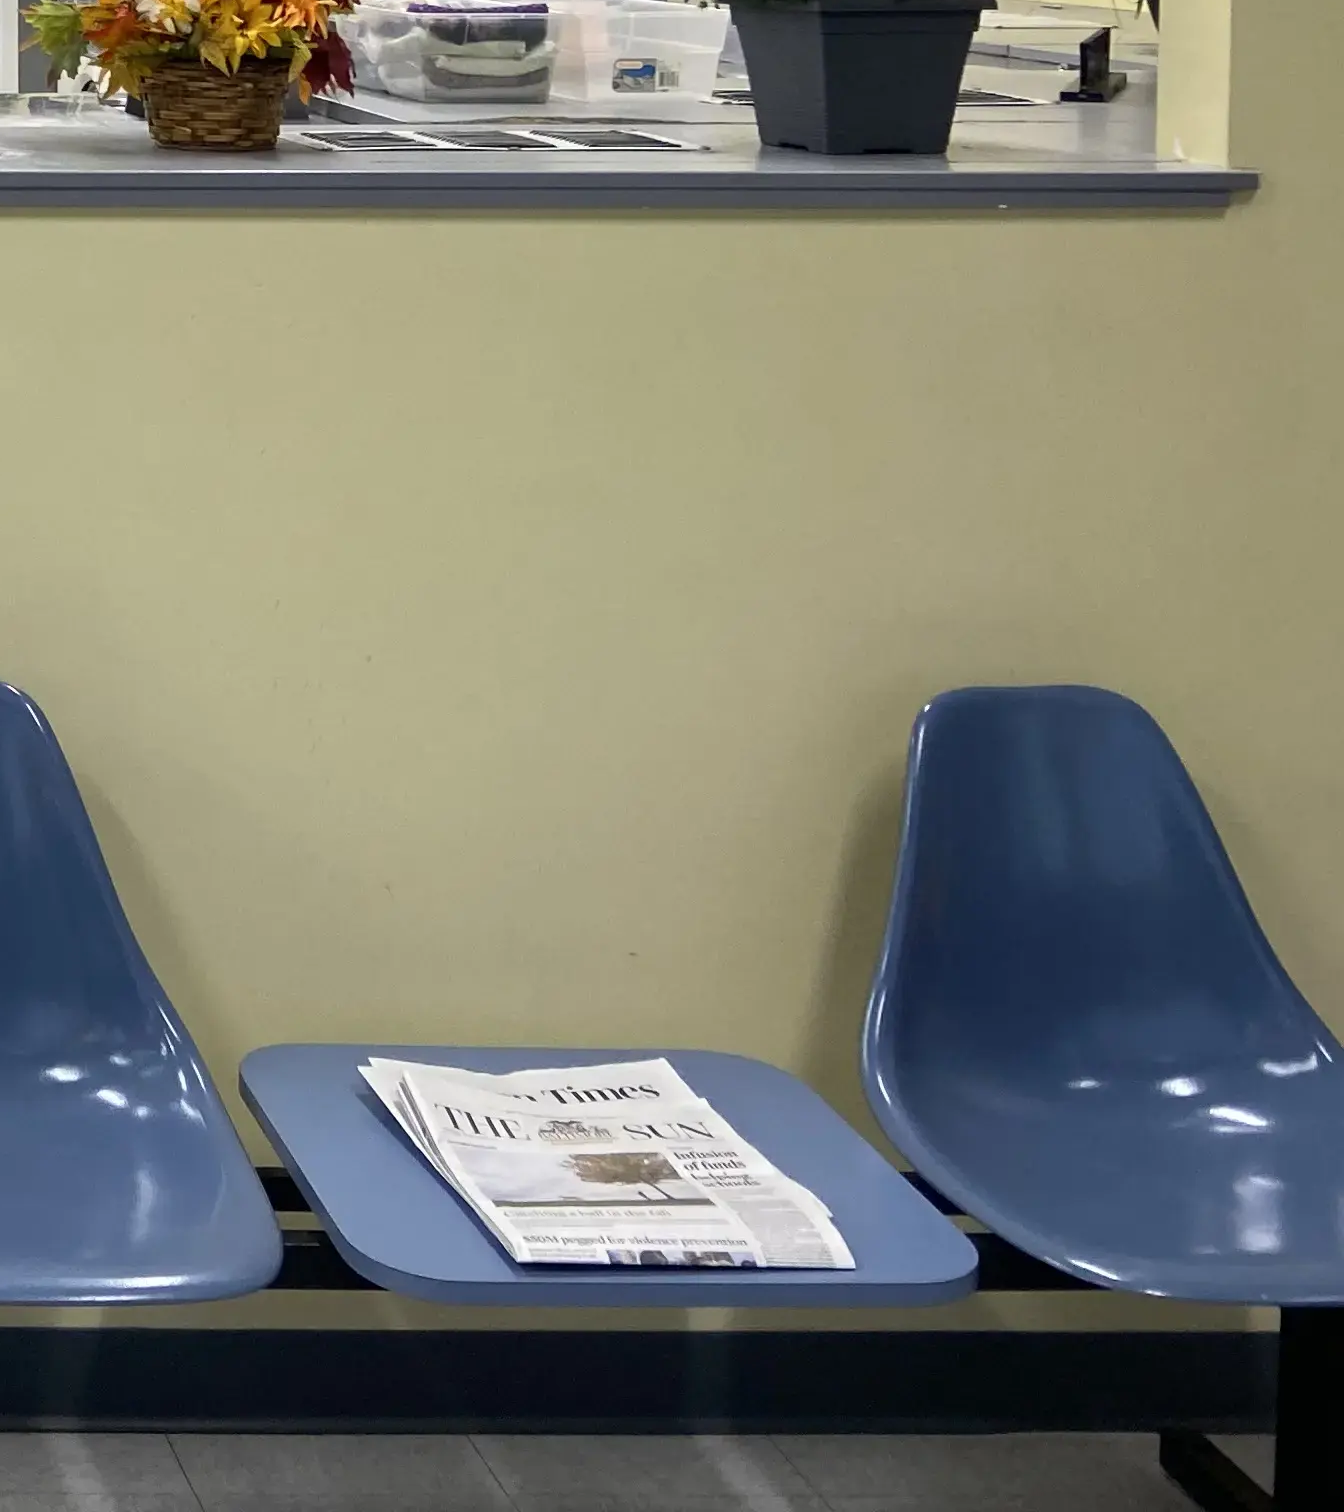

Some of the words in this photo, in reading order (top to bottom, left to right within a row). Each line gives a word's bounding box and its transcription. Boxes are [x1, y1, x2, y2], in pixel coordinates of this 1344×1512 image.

[541, 1083, 661, 1105] Times
[433, 1102, 532, 1141] THE
[621, 1120, 716, 1140] SUN
[681, 1237, 749, 1248] prevention
